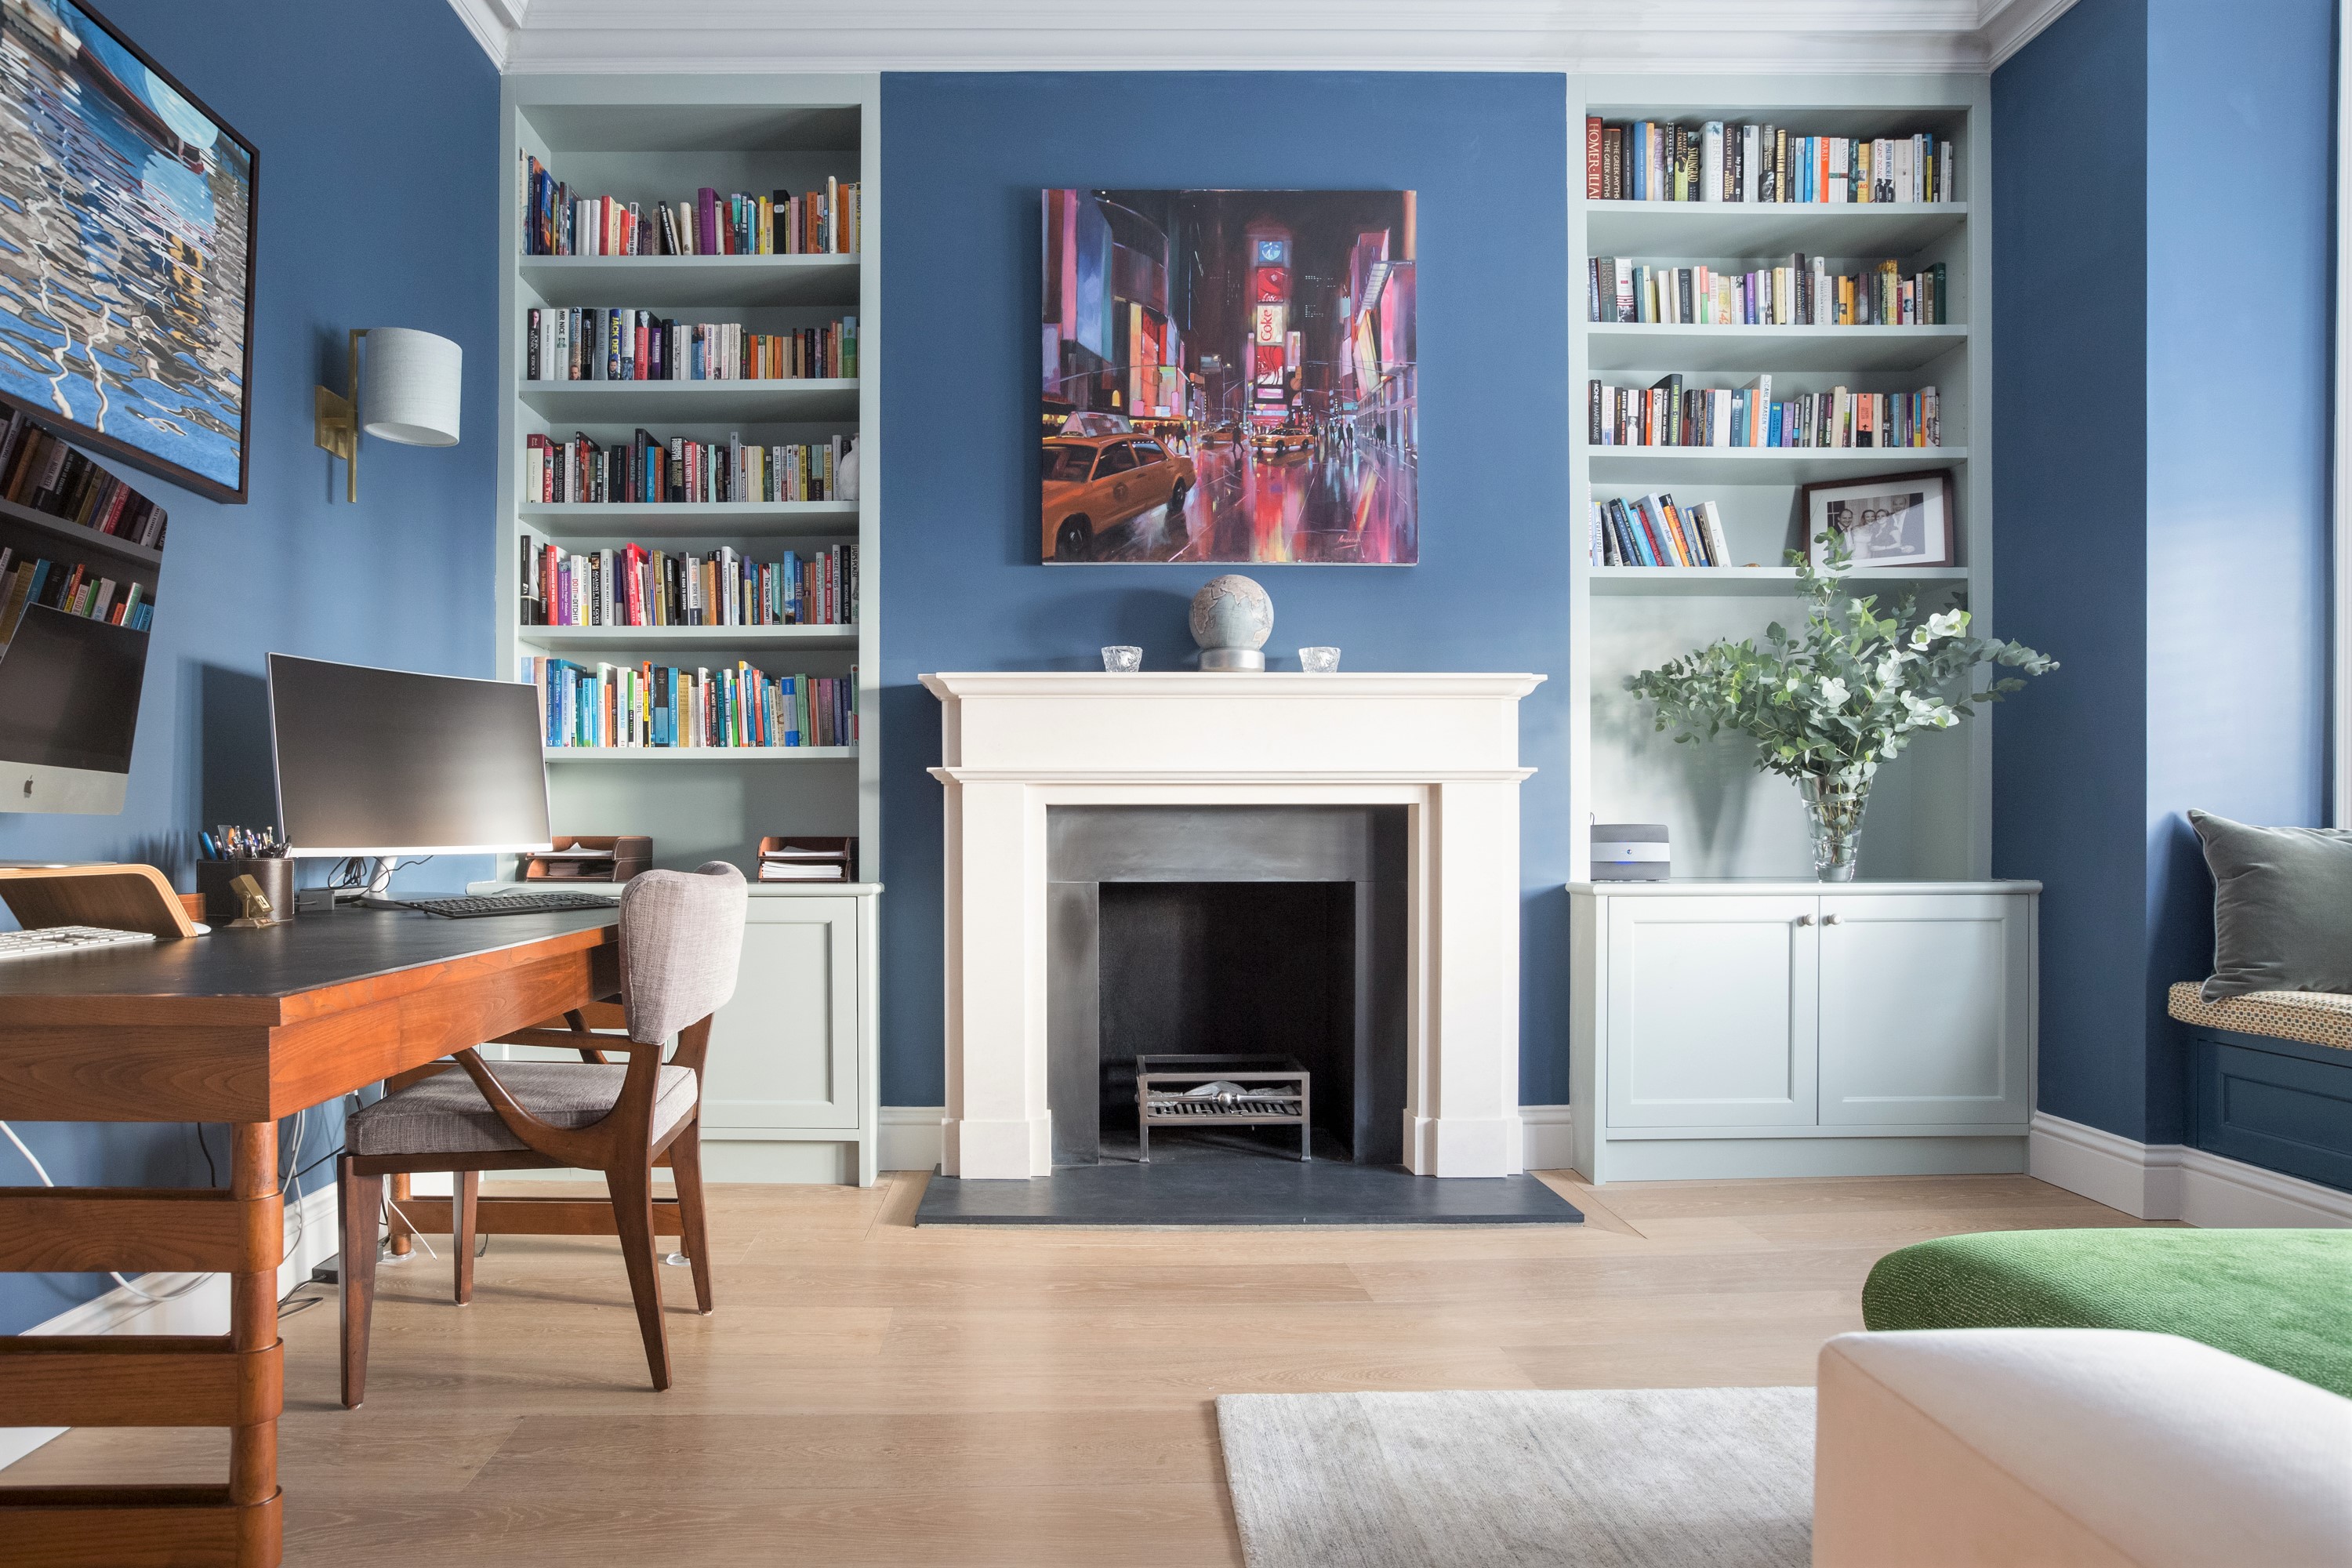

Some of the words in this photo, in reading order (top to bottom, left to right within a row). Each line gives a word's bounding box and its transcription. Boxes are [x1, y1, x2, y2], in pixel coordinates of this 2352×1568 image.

[1688, 147, 1698, 183] STALINGRAD
[559, 310, 565, 320] MR
[1261, 310, 1272, 342] Coke
